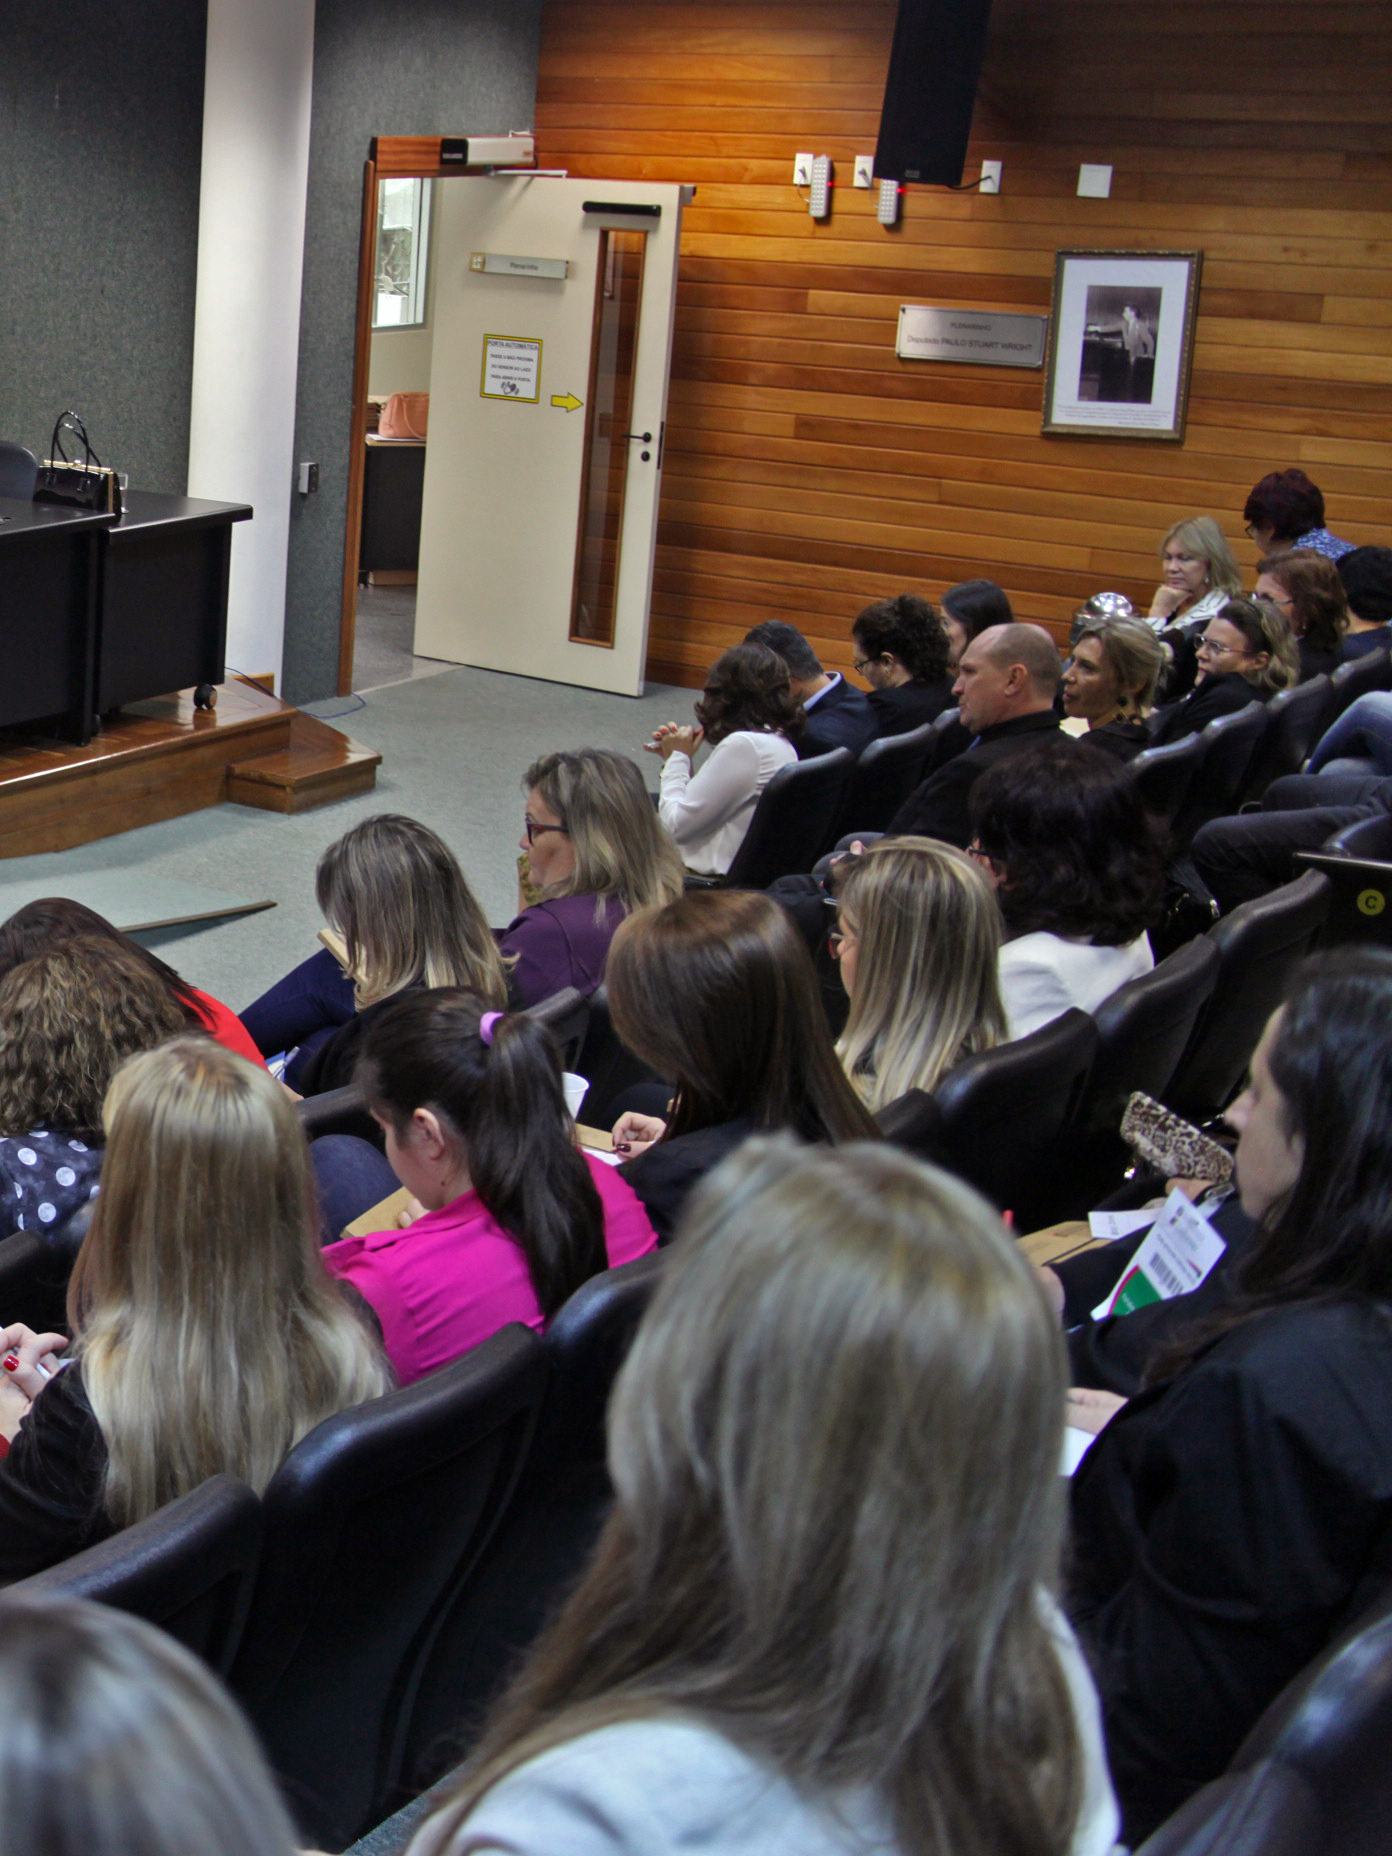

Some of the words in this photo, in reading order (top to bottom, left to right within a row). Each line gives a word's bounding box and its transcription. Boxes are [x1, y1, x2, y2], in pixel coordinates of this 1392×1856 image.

[907, 335, 940, 346] Deputado
[941, 337, 967, 347] PAULO
[968, 339, 1000, 348] STUART
[1000, 341, 1033, 351] WRIGHT
